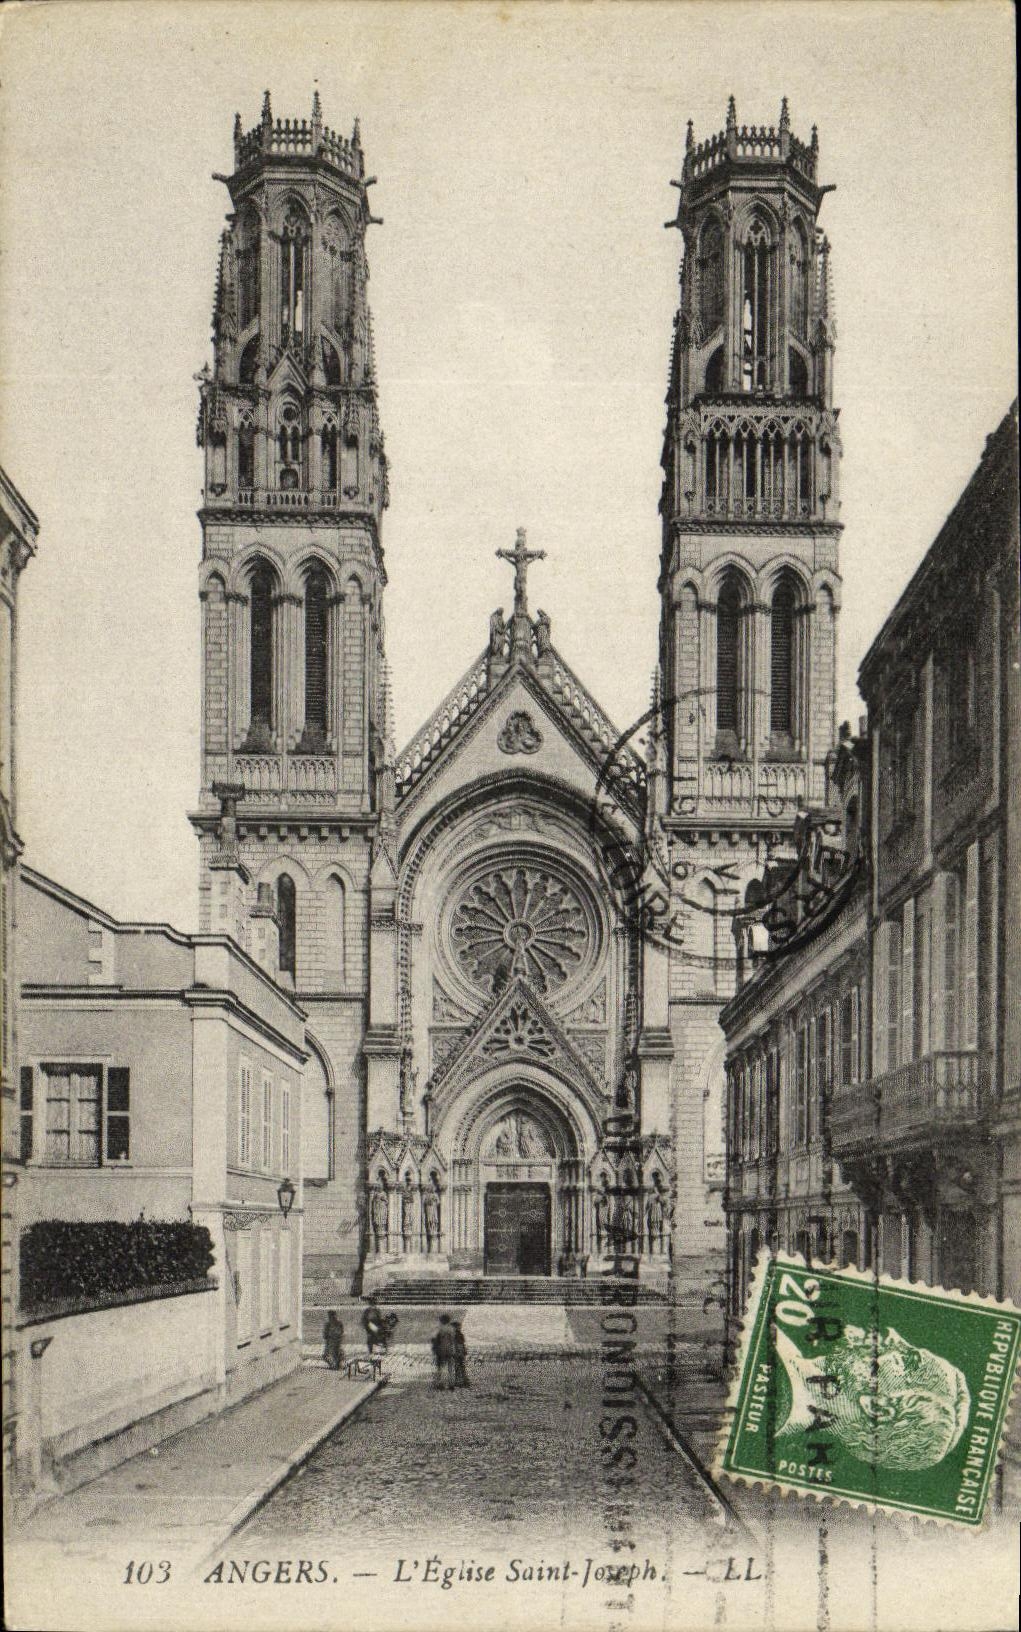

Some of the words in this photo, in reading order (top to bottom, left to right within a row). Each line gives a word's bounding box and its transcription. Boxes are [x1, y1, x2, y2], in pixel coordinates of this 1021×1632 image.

[773, 1272, 820, 1327] 20
[744, 1362, 773, 1433] PASTEUR
[953, 1425, 992, 1517] FRANÇAISE
